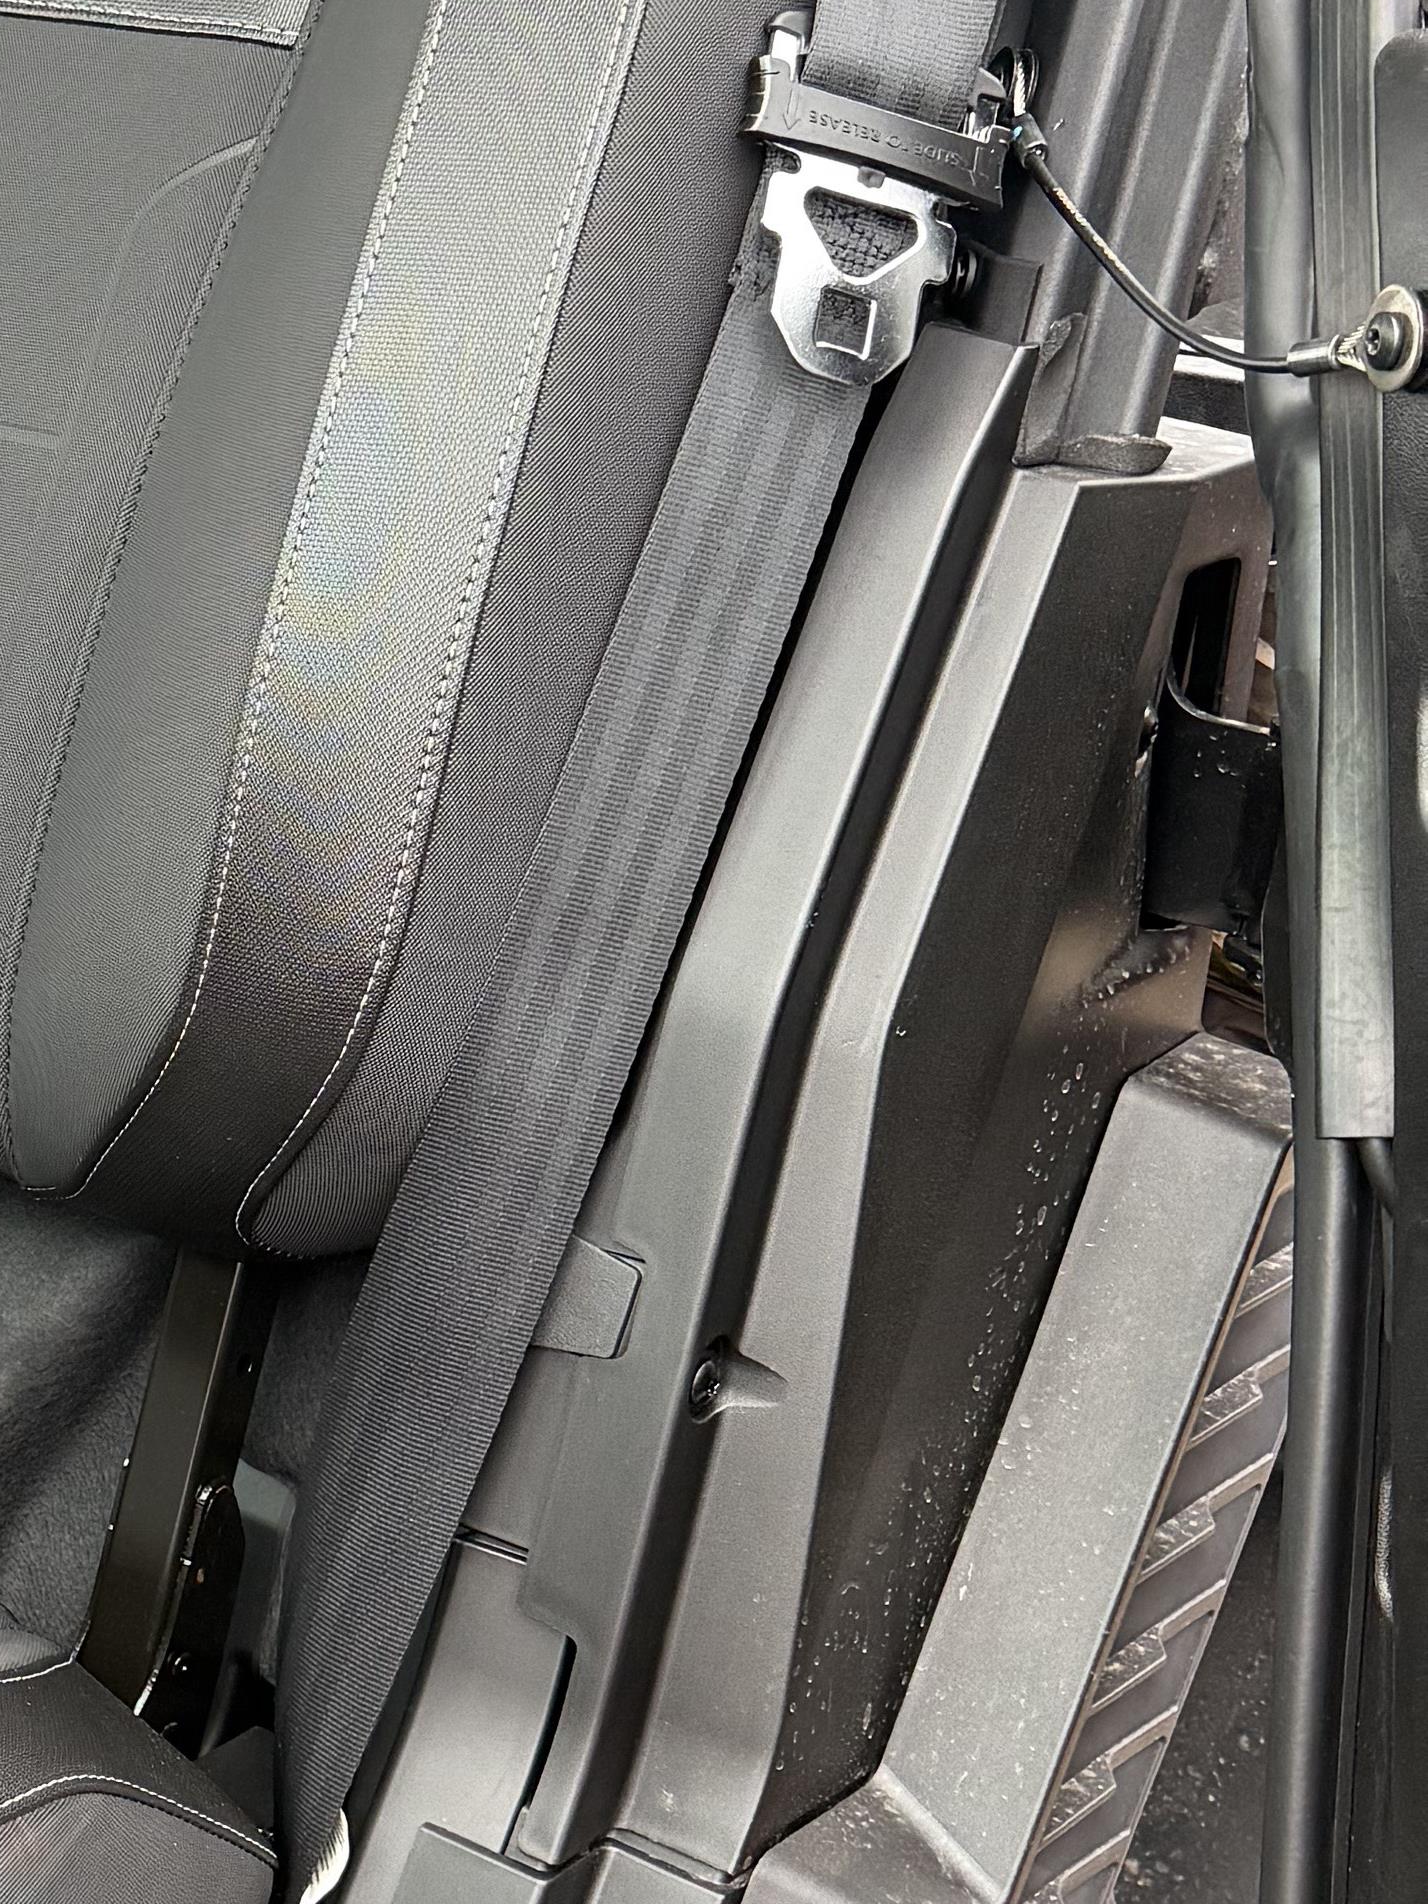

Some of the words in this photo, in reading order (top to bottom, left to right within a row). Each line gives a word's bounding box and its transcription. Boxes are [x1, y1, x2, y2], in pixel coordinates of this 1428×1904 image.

[809, 109, 883, 143] RELEASE
[885, 134, 909, 152] TO
[914, 142, 960, 167] SLIDE
